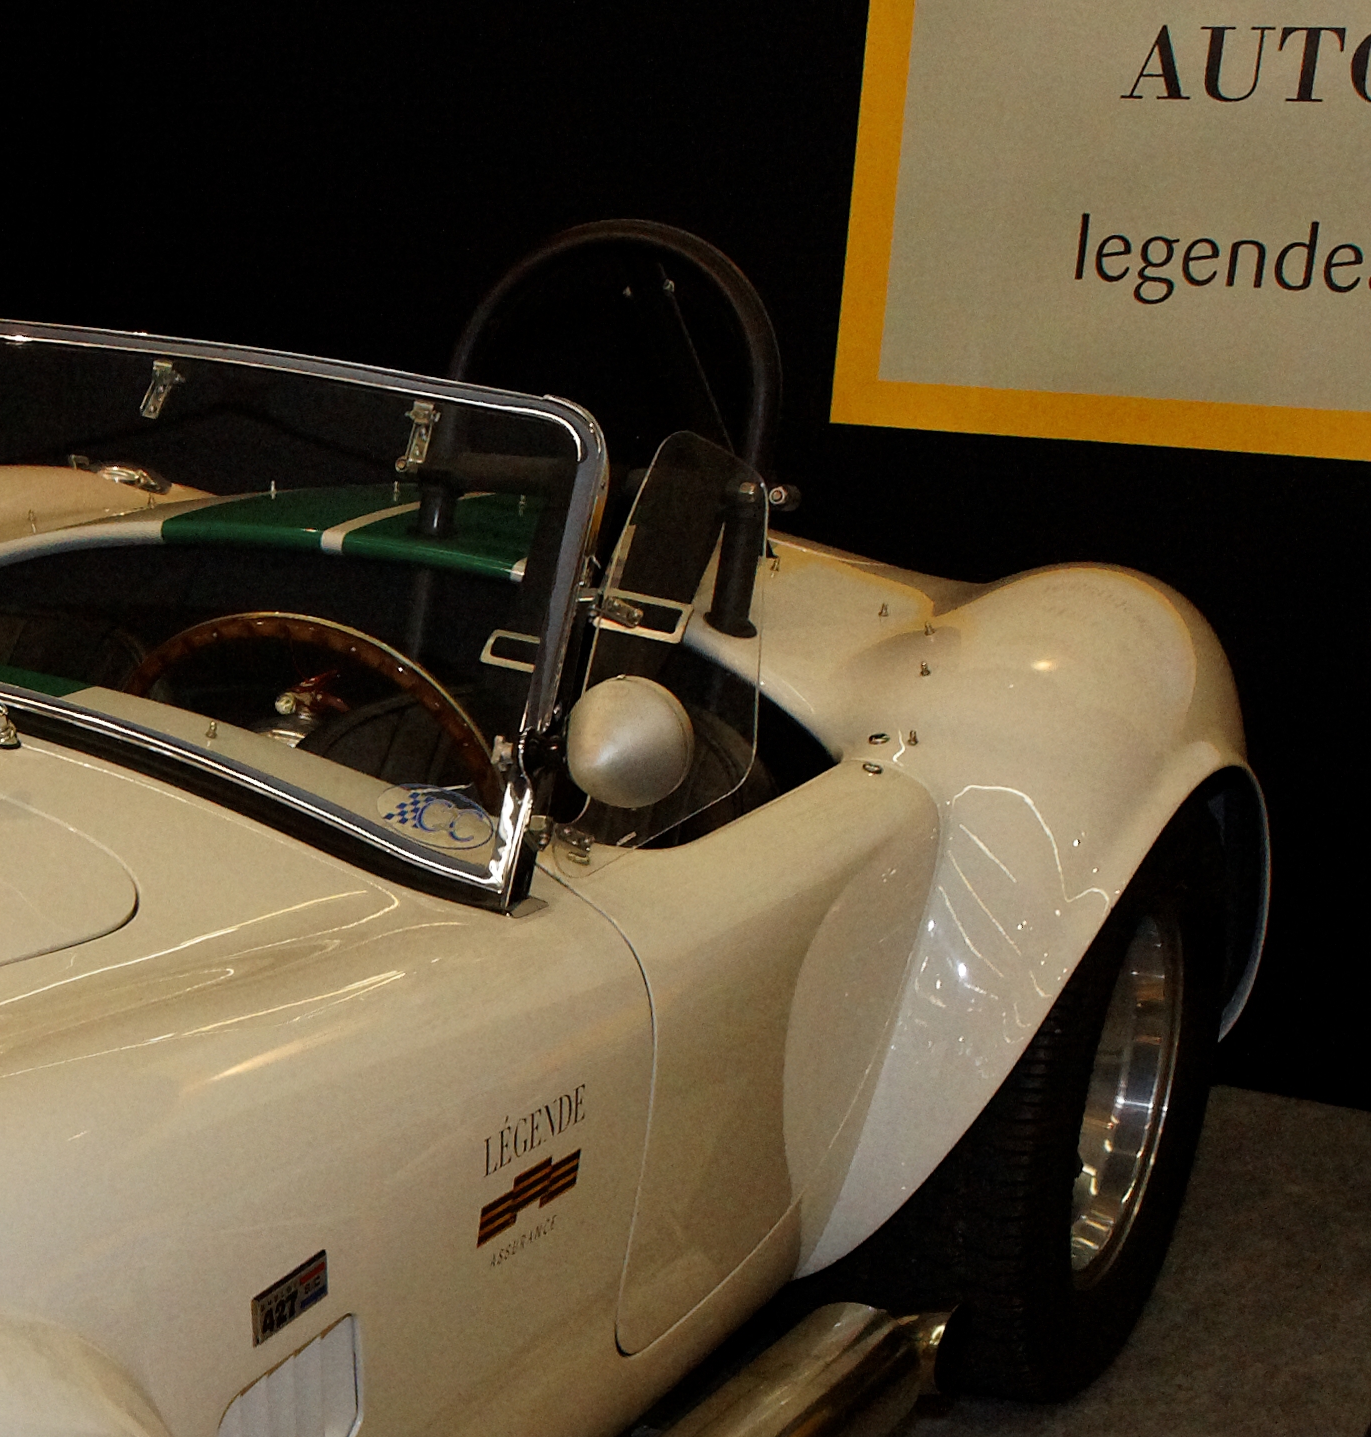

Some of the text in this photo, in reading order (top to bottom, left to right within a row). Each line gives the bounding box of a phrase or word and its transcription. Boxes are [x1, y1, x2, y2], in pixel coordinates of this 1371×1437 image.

[1073, 211, 1371, 305] legende
[483, 1083, 586, 1179] LÉGENDE
[260, 1289, 299, 1335] 427
